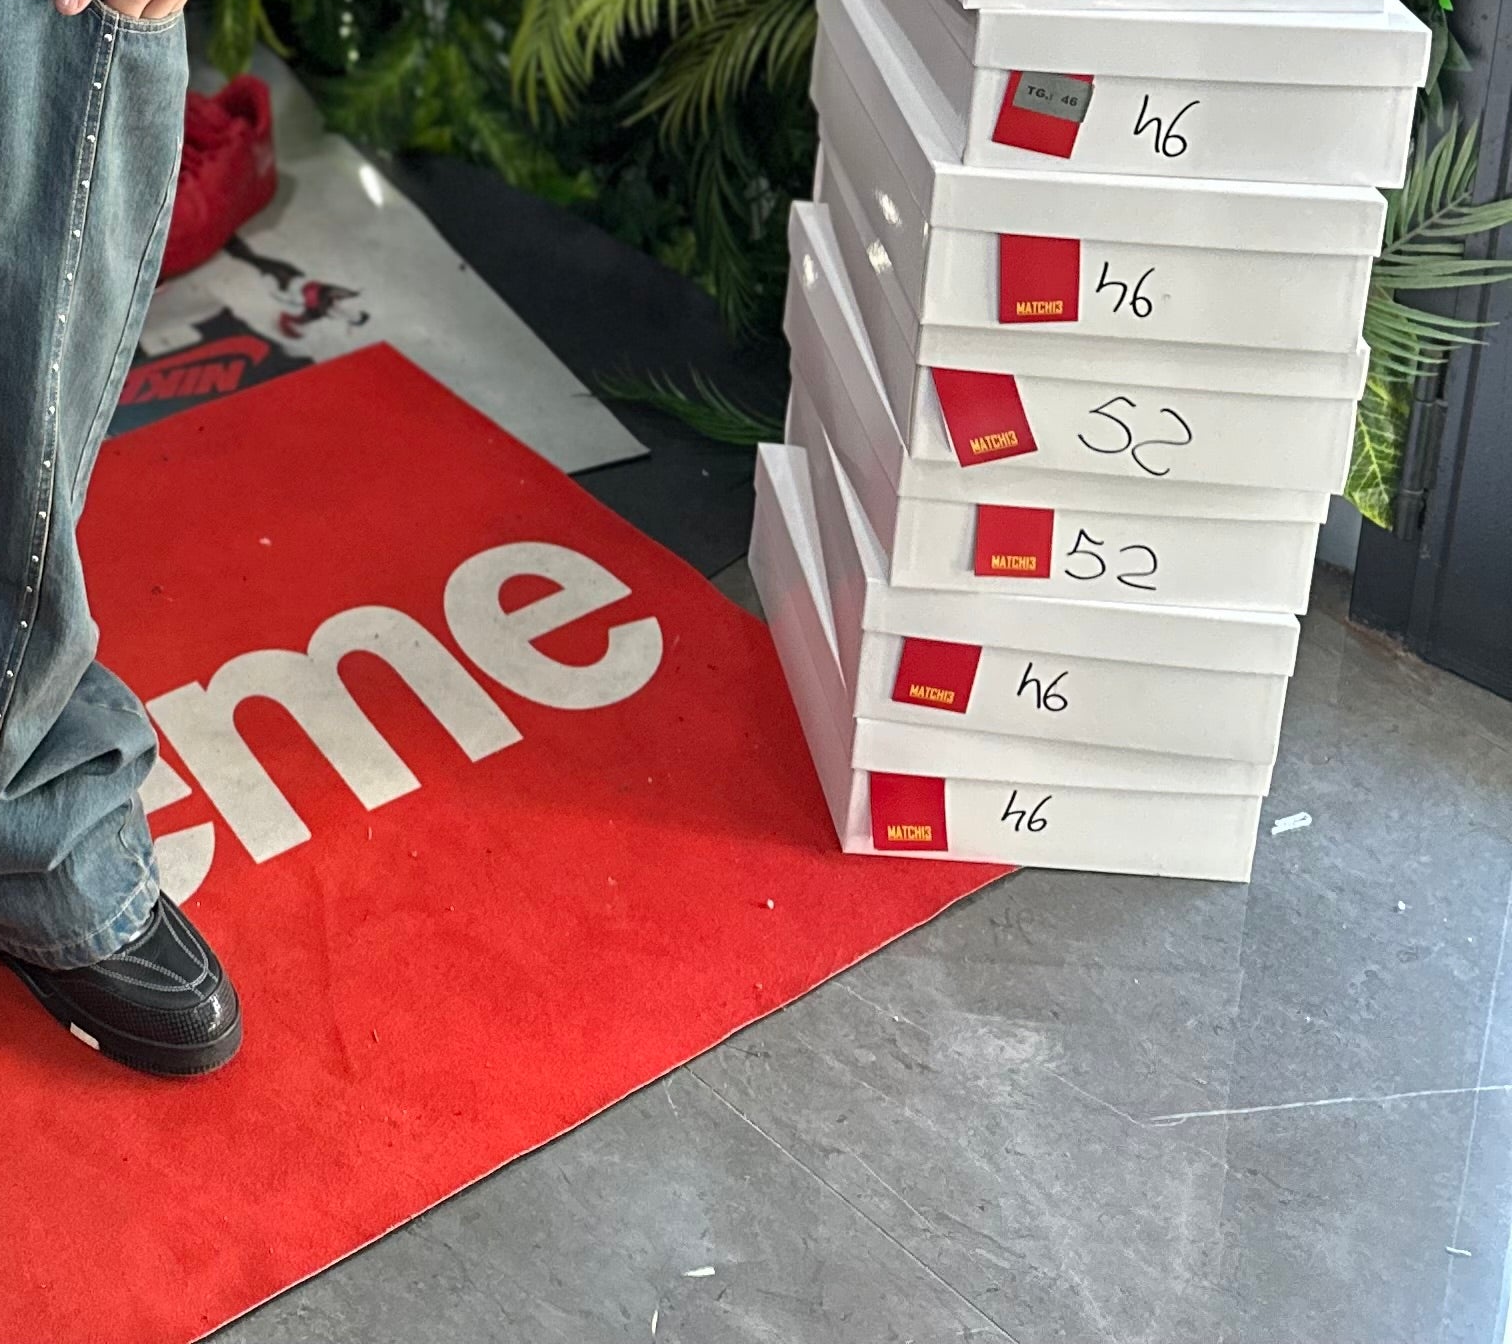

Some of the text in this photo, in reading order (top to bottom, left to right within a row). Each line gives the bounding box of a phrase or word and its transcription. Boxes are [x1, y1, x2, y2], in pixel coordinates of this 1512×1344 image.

[1061, 95, 1078, 107] 46
[1133, 94, 1201, 158] 46
[1096, 261, 1155, 318] 46
[1016, 300, 1064, 316] MATCH13
[969, 430, 1019, 455] MATCH13
[1077, 396, 1193, 477] 52
[991, 555, 1037, 571] MATCH13
[1064, 529, 1158, 591] 52
[908, 683, 955, 704] MATCH13
[1016, 662, 1069, 712] 46
[1001, 790, 1052, 832] 46
[887, 825, 933, 842] MATCH13
